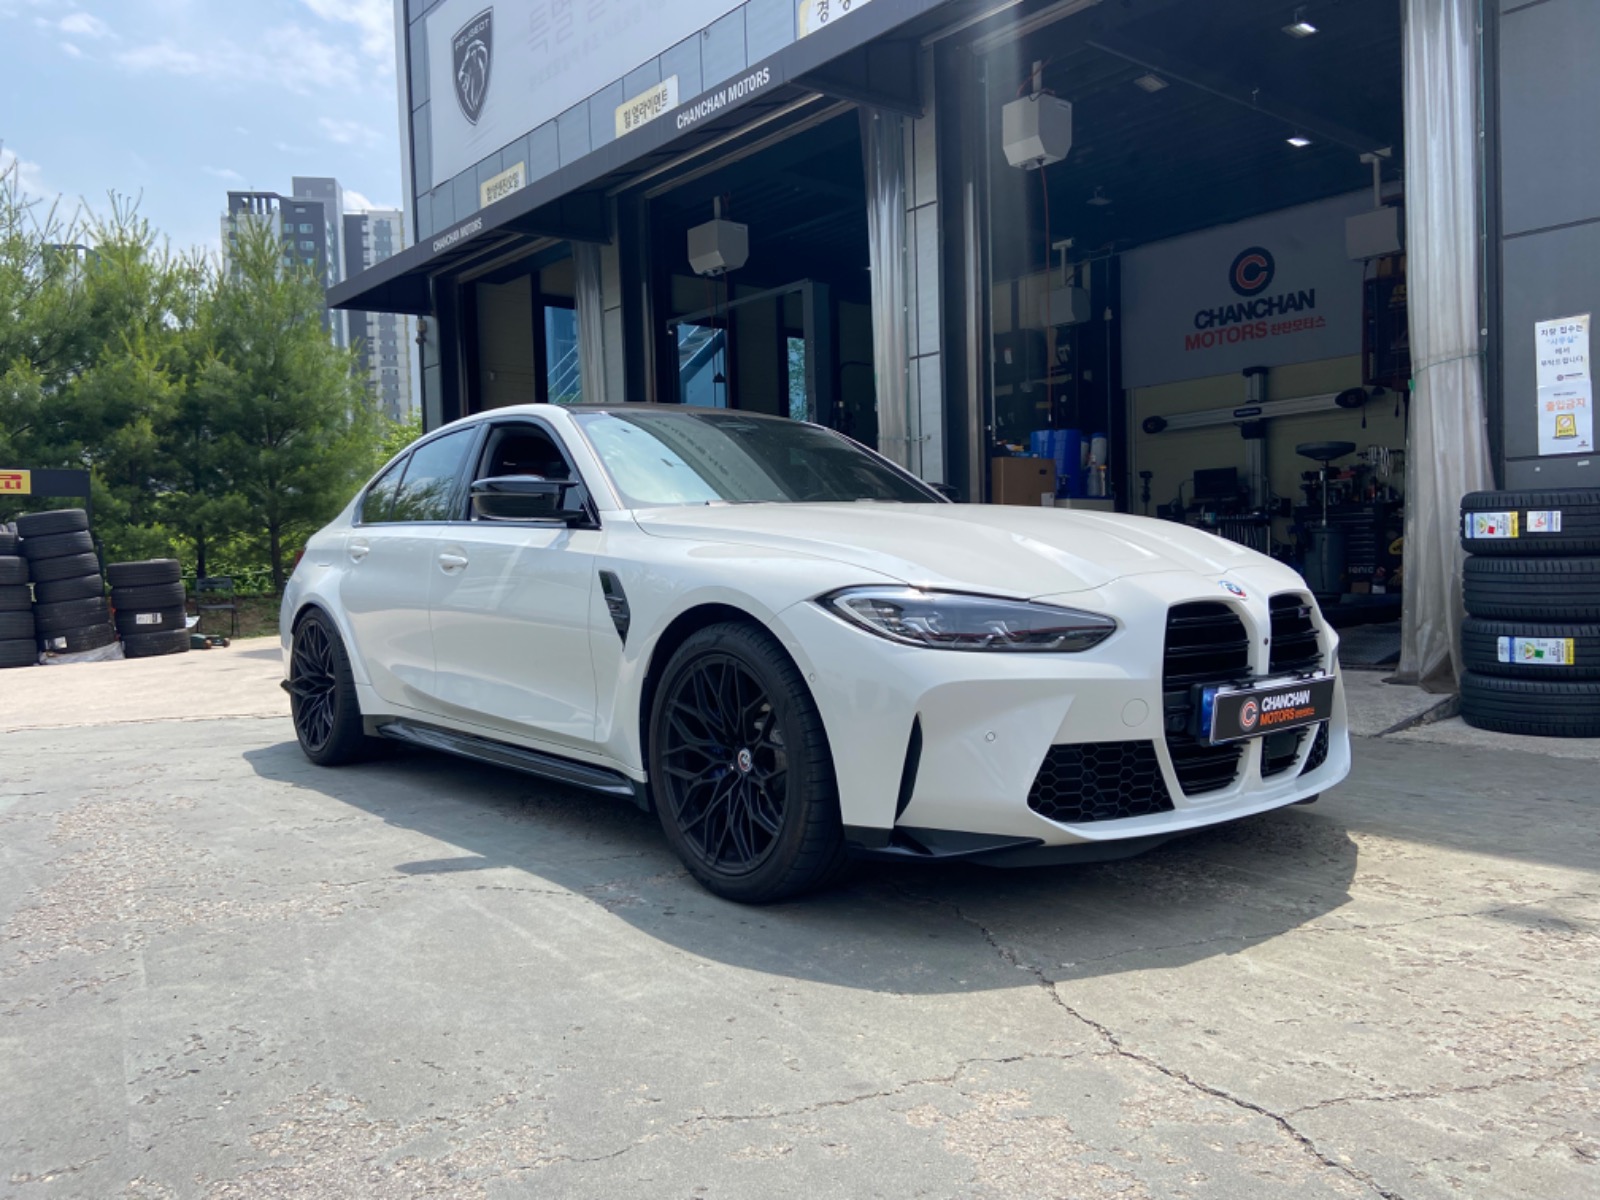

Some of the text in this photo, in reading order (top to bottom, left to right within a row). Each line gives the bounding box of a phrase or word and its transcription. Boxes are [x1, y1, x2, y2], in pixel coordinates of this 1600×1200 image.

[455, 19, 489, 51] PEUGEOT
[676, 67, 770, 129] CHANCHAN MOTORS
[433, 217, 482, 252] CHANCHAN MOTORS
[1193, 288, 1315, 330] CHANCHAN
[1185, 320, 1268, 351] MOTORS
[1260, 708, 1295, 726] MOTORS
[1262, 690, 1310, 712] CHANCHAN
